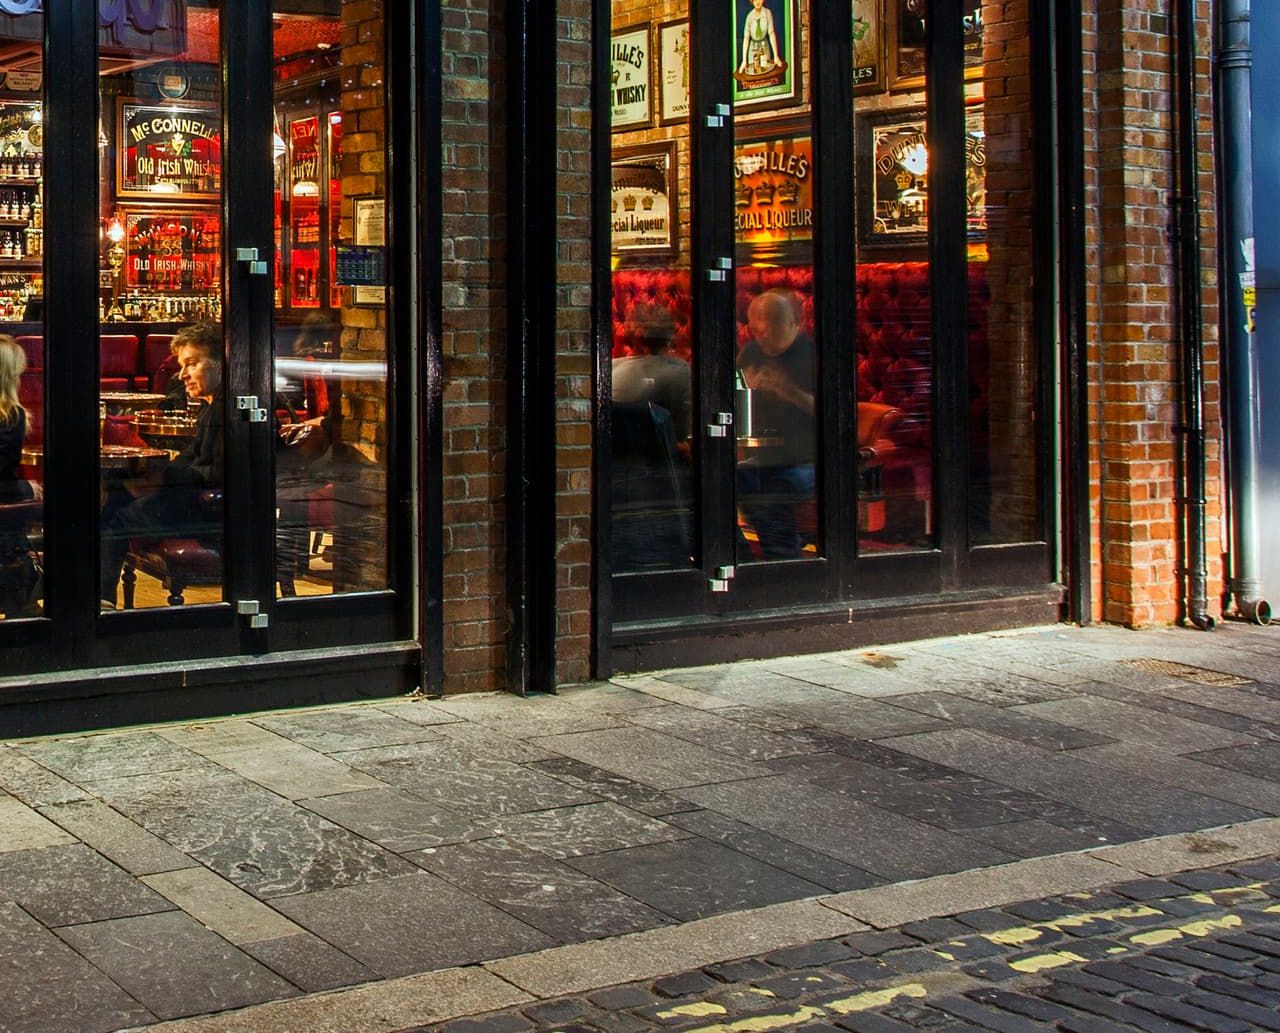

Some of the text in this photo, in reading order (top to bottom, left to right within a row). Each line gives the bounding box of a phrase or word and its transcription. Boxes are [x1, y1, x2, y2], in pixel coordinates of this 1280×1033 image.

[616, 83, 647, 106] WHISKY
[137, 156, 155, 174] Old
[158, 156, 182, 176] Irish
[630, 214, 665, 235] Liqueur
[766, 209, 812, 229] LIQUEUR
[133, 258, 150, 271] OLD
[154, 258, 177, 271] IRISH
